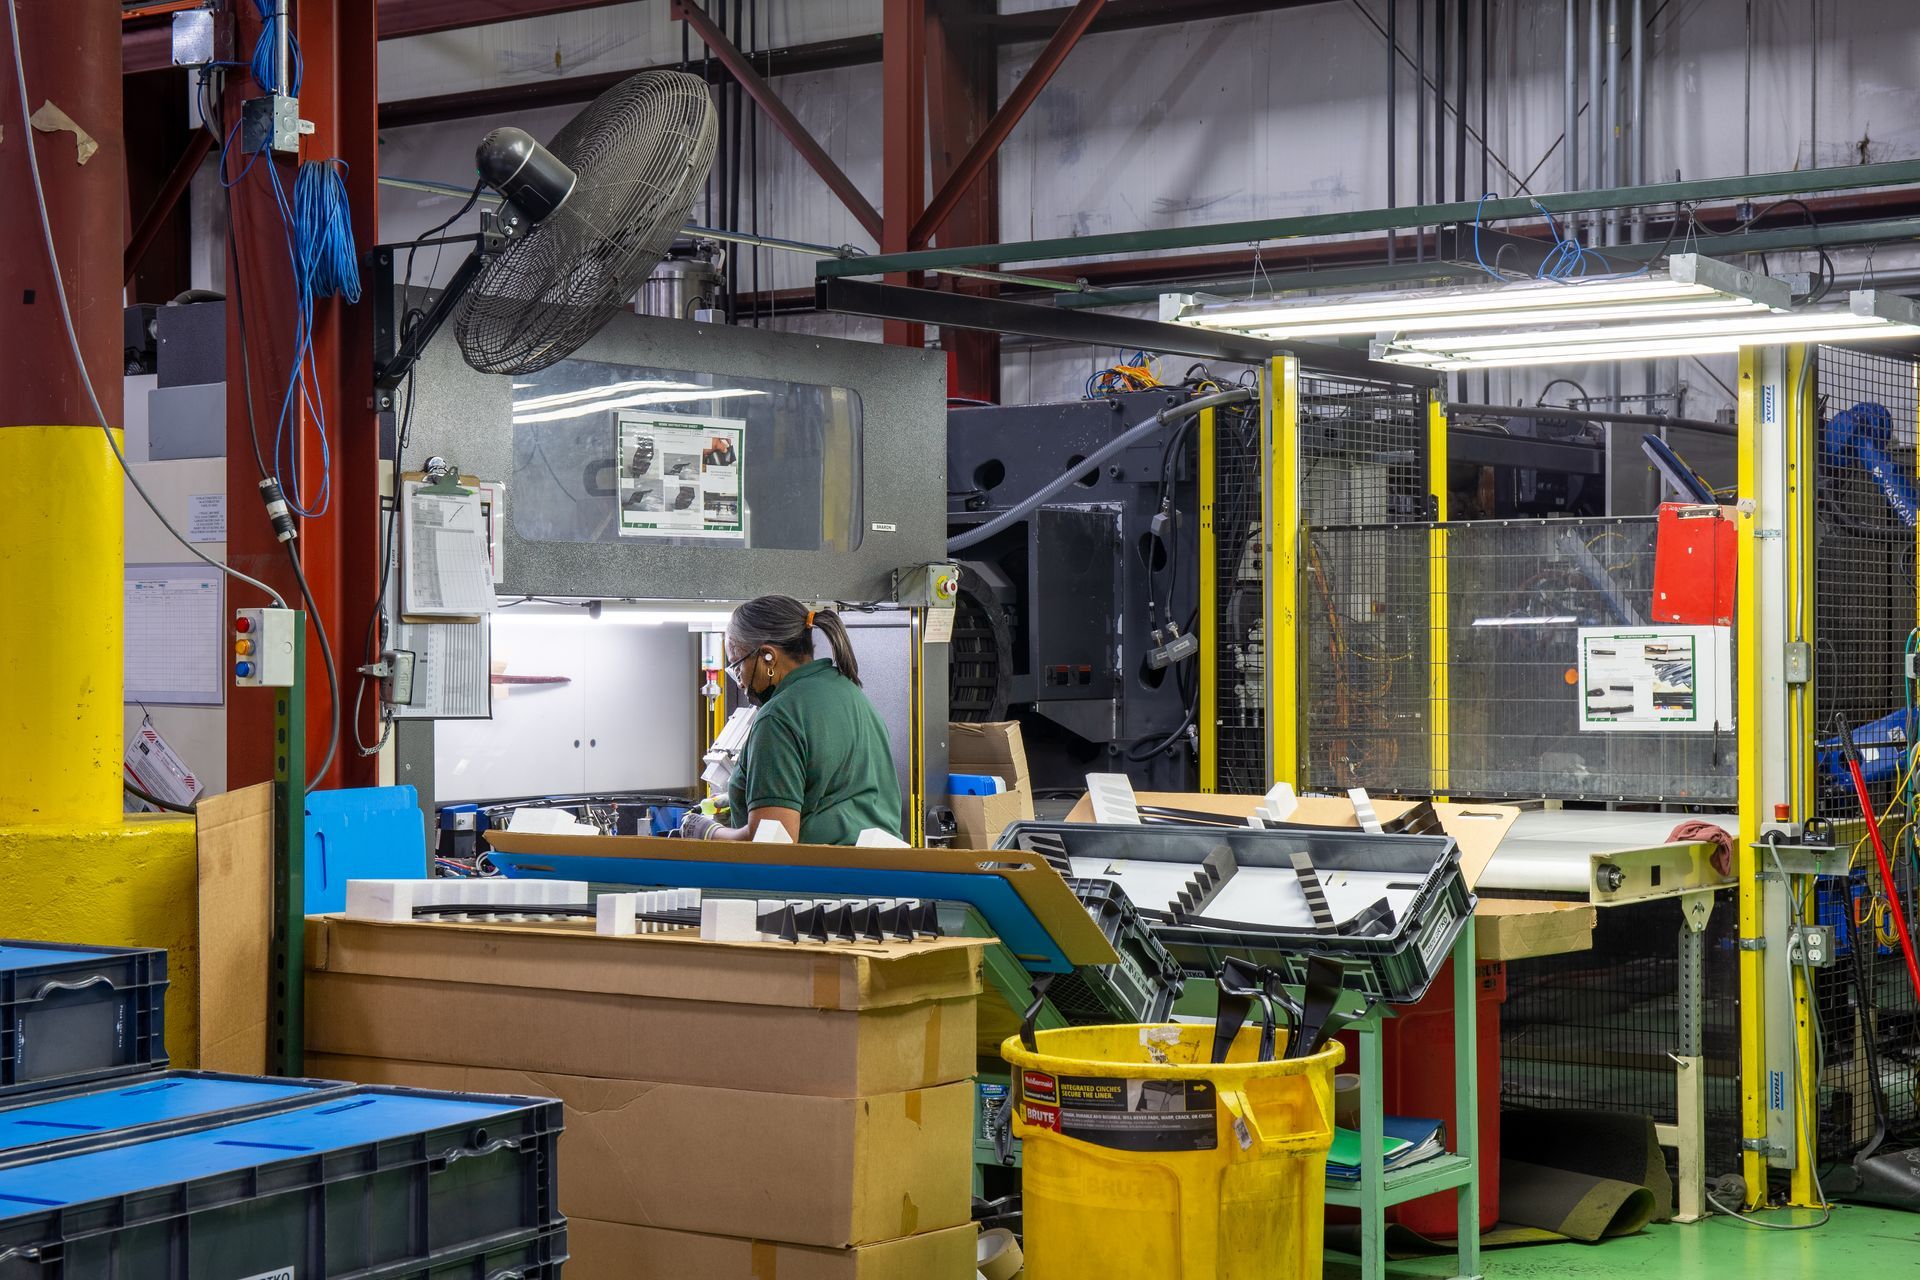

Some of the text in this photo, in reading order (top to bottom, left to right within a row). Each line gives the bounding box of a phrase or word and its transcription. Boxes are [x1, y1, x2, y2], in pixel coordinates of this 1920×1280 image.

[1061, 1084, 1095, 1092] INTEGRATED
[1062, 1090, 1082, 1098] SECURE
[1027, 1108, 1054, 1123] BRUTE
